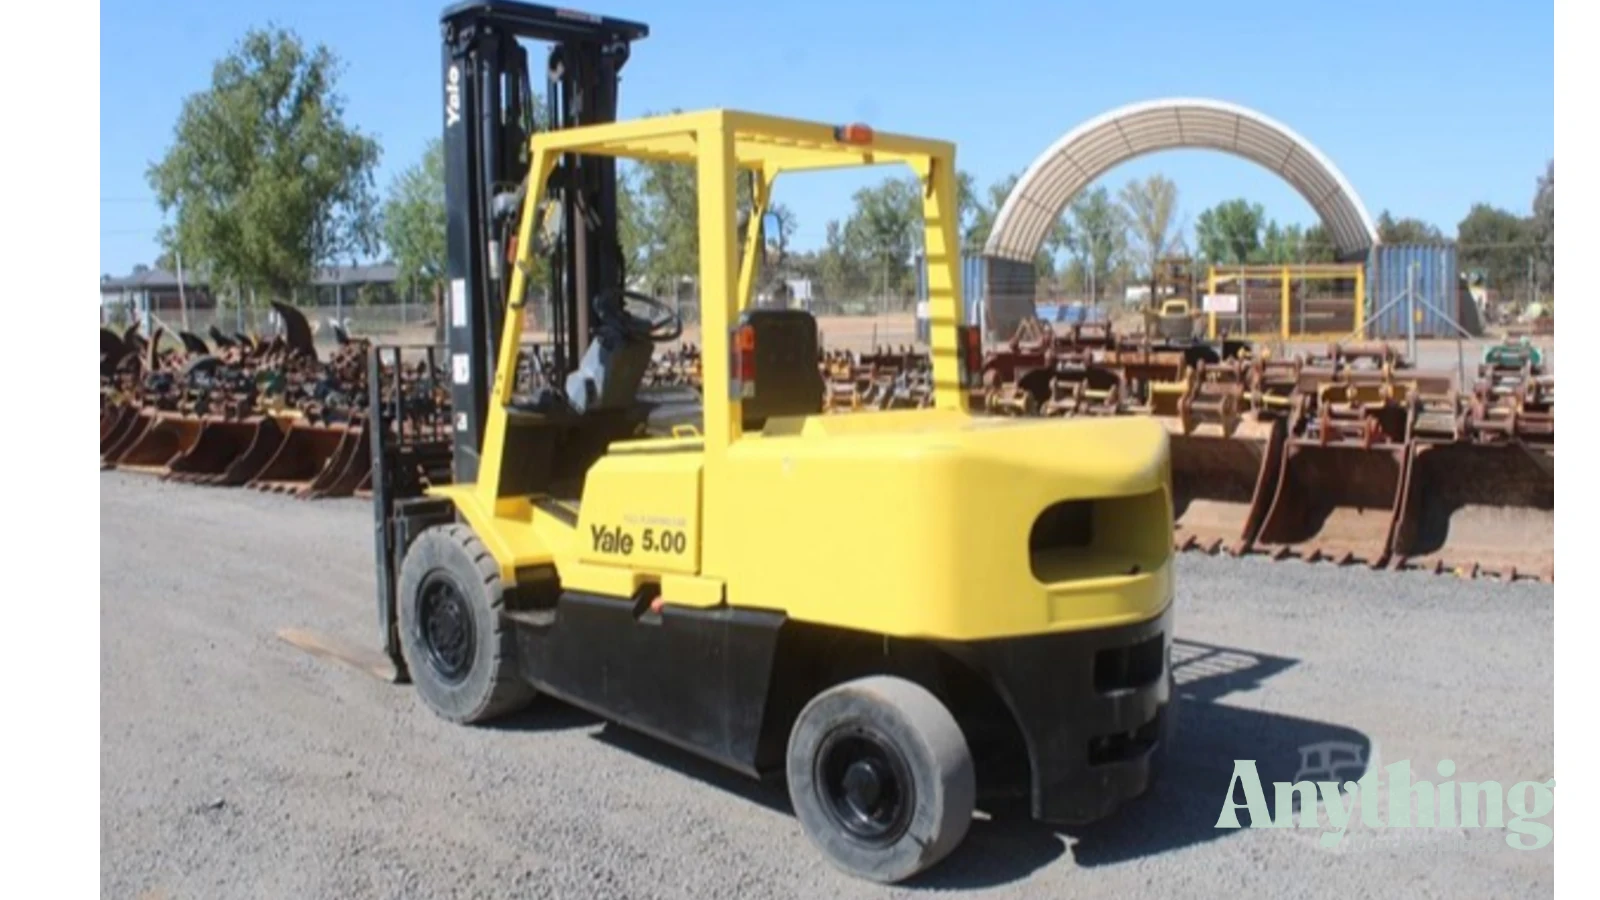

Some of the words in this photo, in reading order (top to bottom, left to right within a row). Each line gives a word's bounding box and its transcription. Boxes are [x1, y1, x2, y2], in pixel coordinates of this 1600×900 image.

[446, 65, 460, 127] Yale
[590, 523, 634, 556] Yale
[641, 528, 687, 555] 5.00
